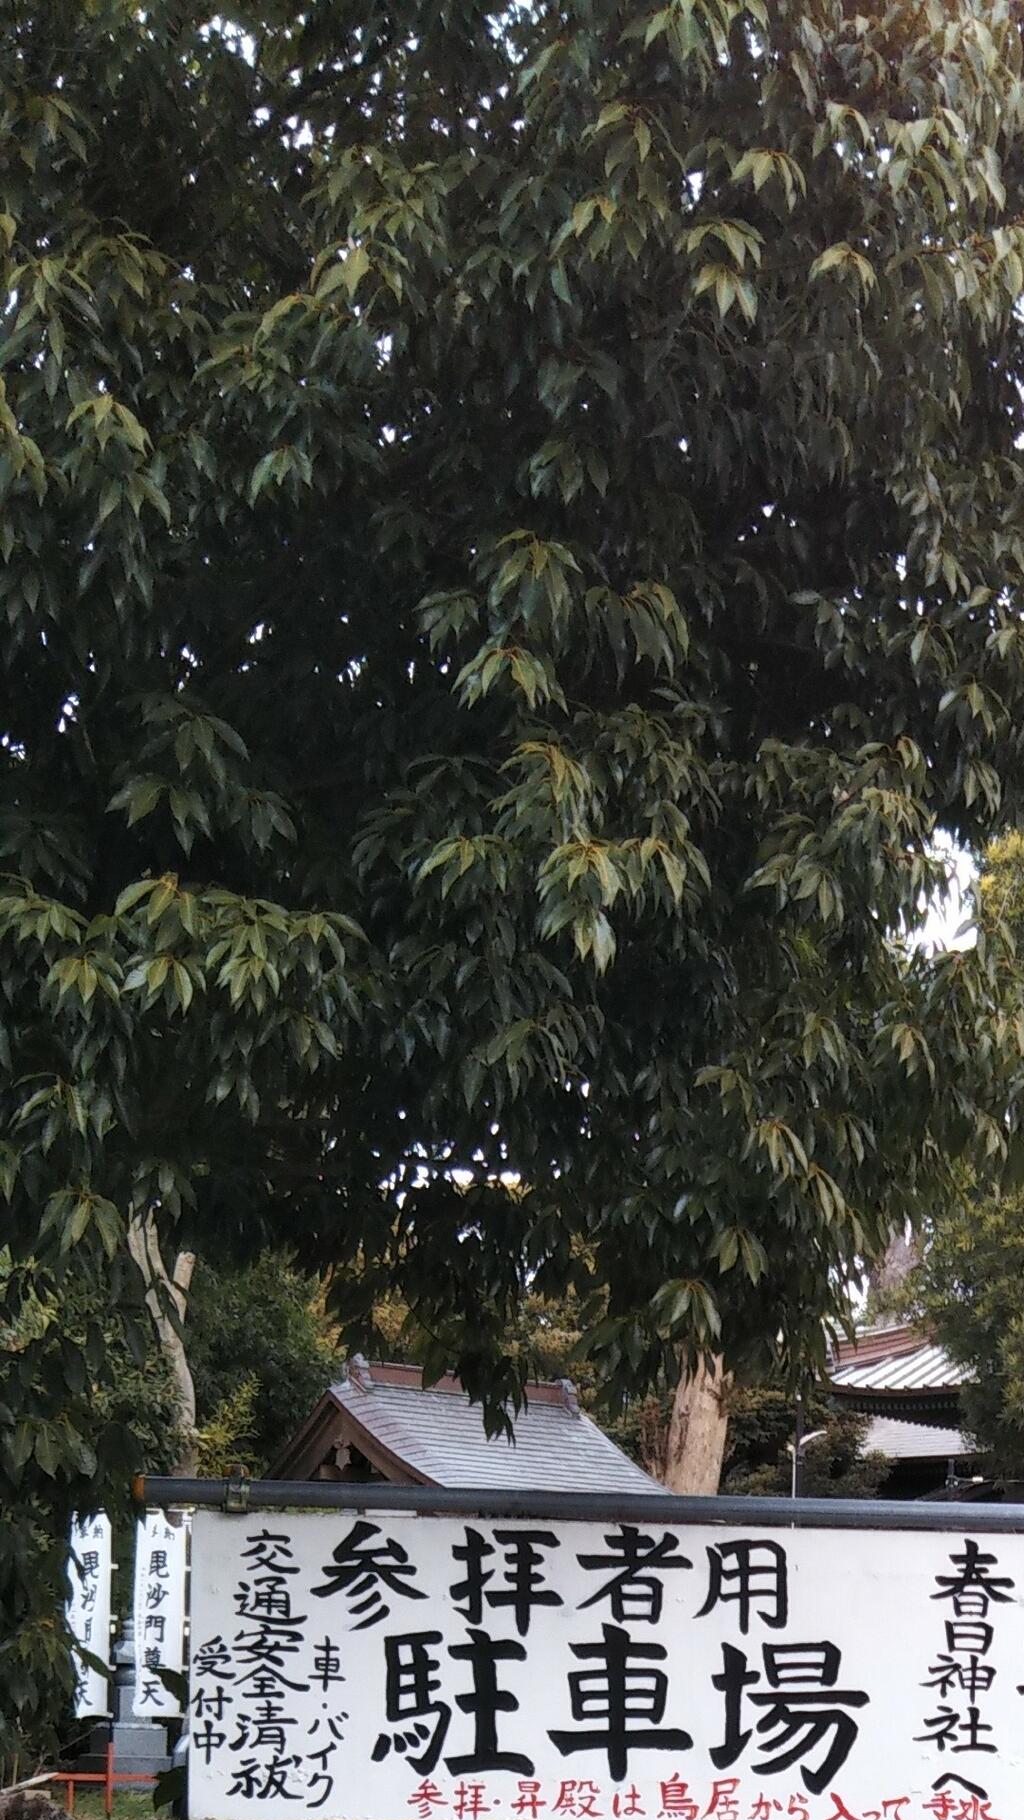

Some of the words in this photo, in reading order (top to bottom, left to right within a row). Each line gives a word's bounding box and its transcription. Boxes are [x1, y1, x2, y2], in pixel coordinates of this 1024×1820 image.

[310, 1520, 788, 1636] 参拝者用
[192, 1635, 237, 1766] 受付中
[371, 1622, 870, 1796] 駐車場
[913, 1538, 1018, 1801] 春日神社へ
